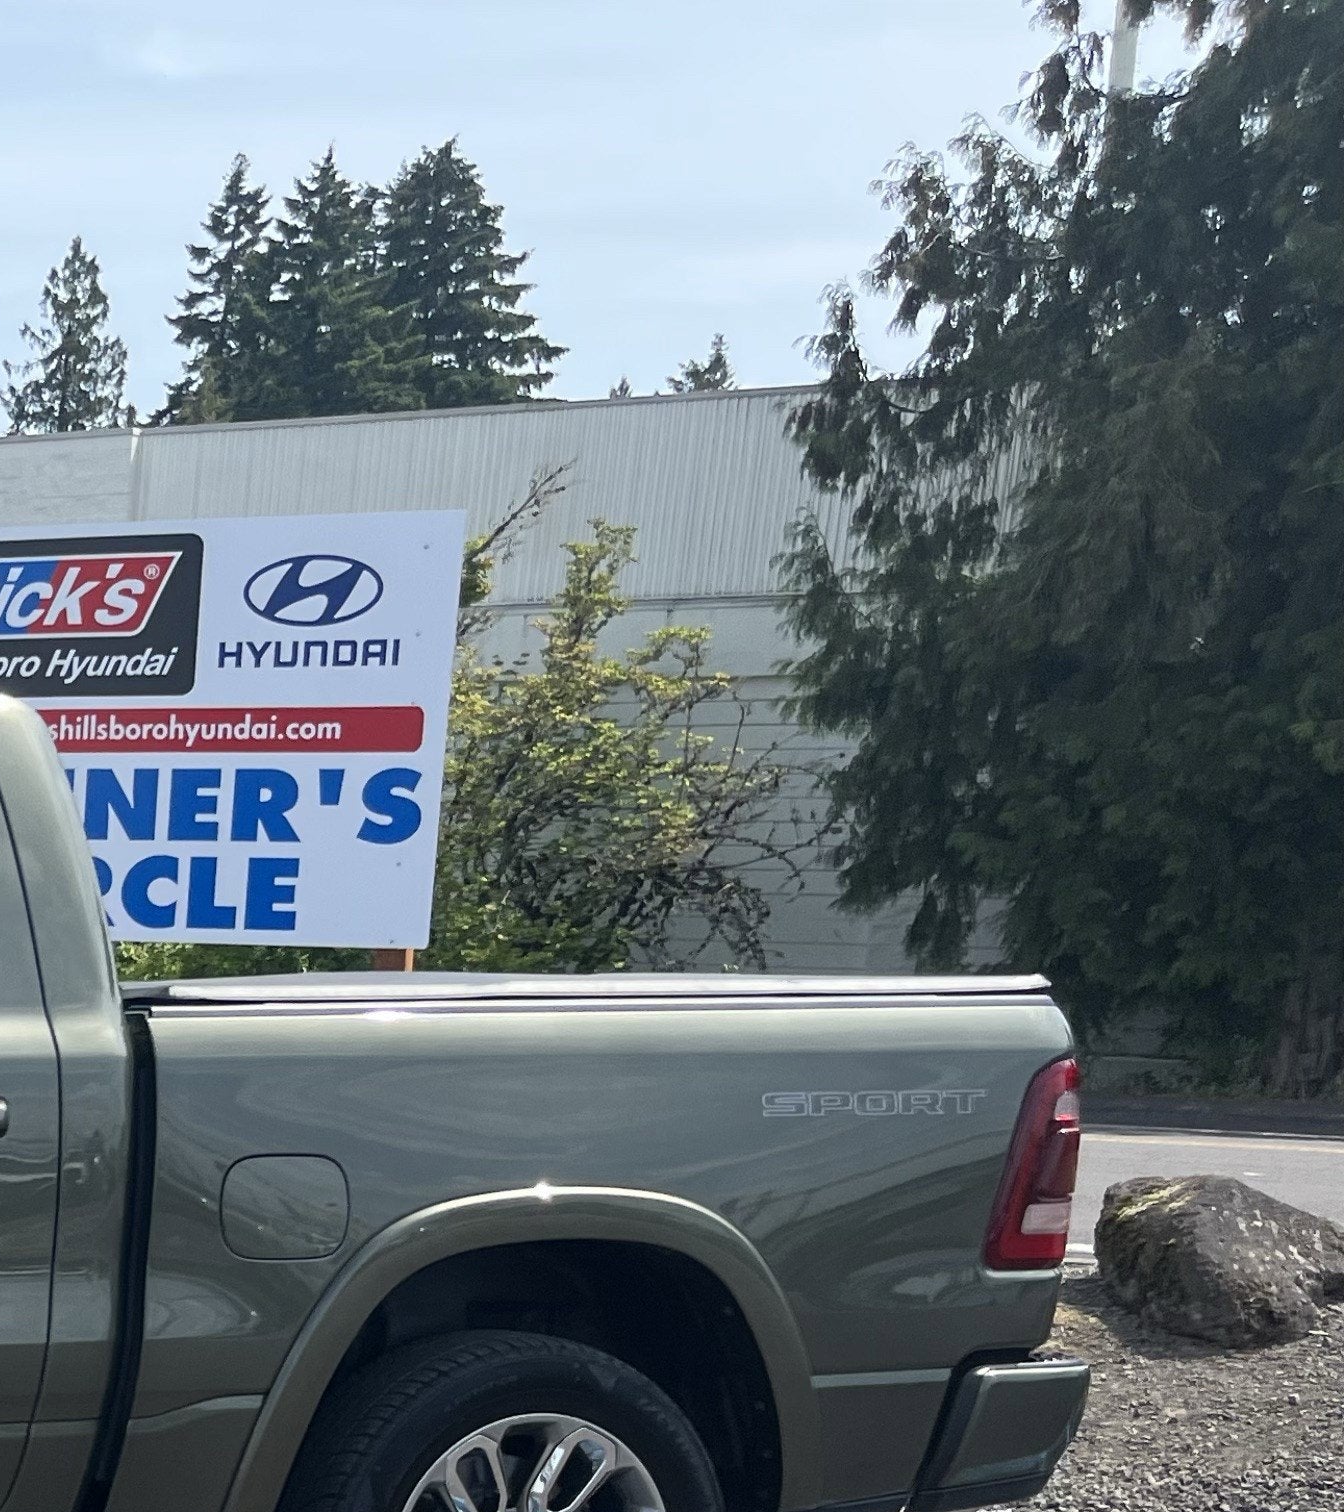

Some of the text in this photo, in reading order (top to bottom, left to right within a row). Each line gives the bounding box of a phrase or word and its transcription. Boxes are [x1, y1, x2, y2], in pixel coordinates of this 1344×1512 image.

[45, 647, 178, 684] Hyundai
[218, 639, 400, 668] HYUNDAI
[762, 1089, 988, 1117] SPORT
